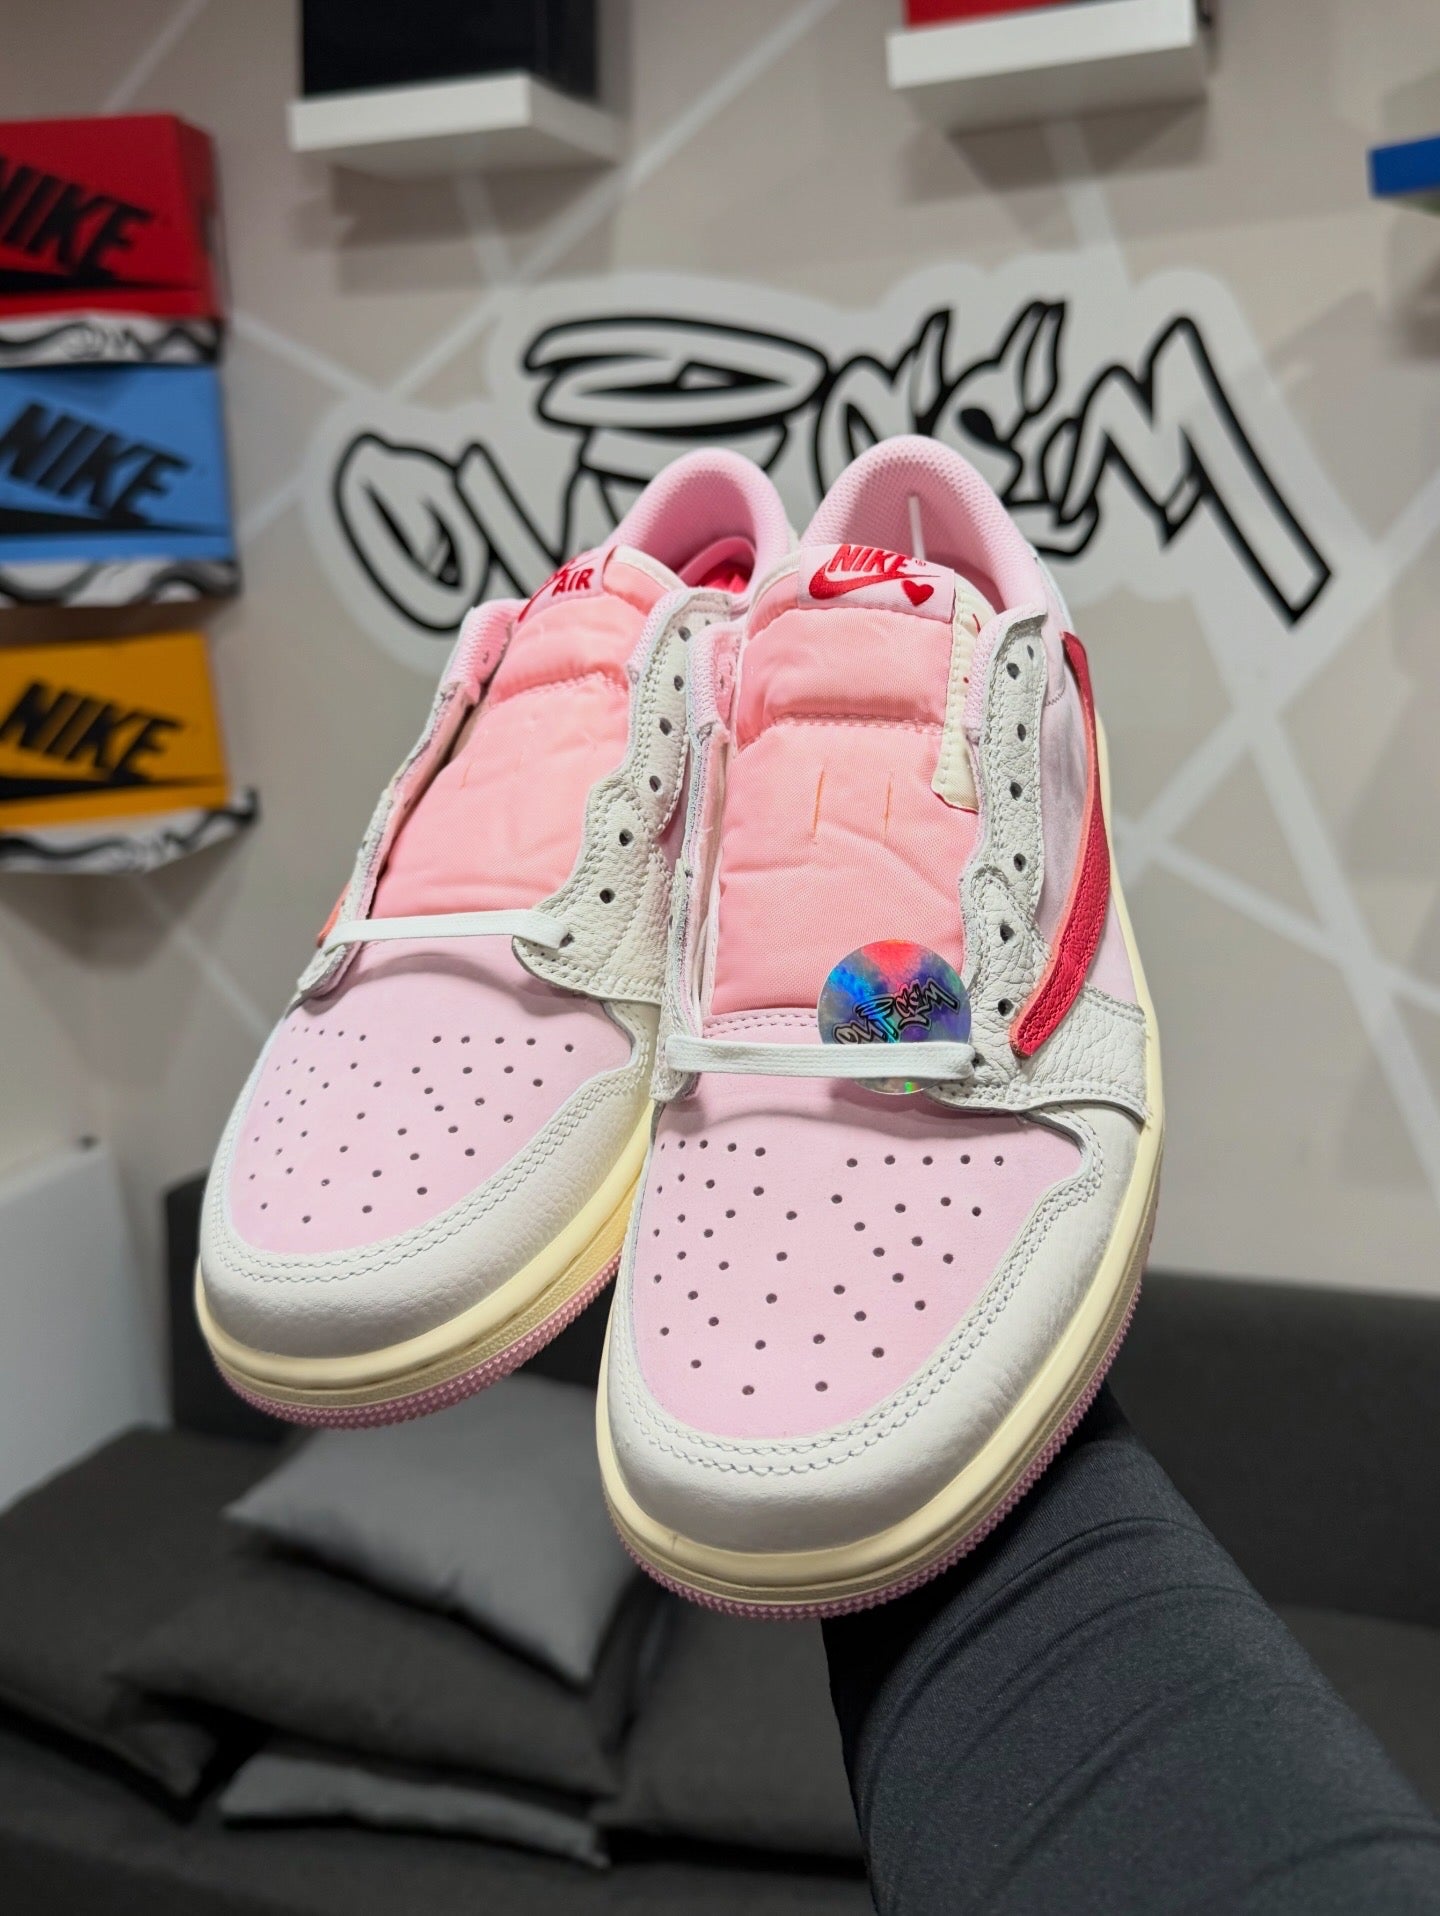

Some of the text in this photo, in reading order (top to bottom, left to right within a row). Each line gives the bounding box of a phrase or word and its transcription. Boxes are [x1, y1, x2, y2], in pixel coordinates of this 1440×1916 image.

[0, 401, 191, 525] NIKE
[551, 567, 595, 597] AIR
[826, 543, 912, 574] NIKE
[0, 682, 184, 784] NIKE
